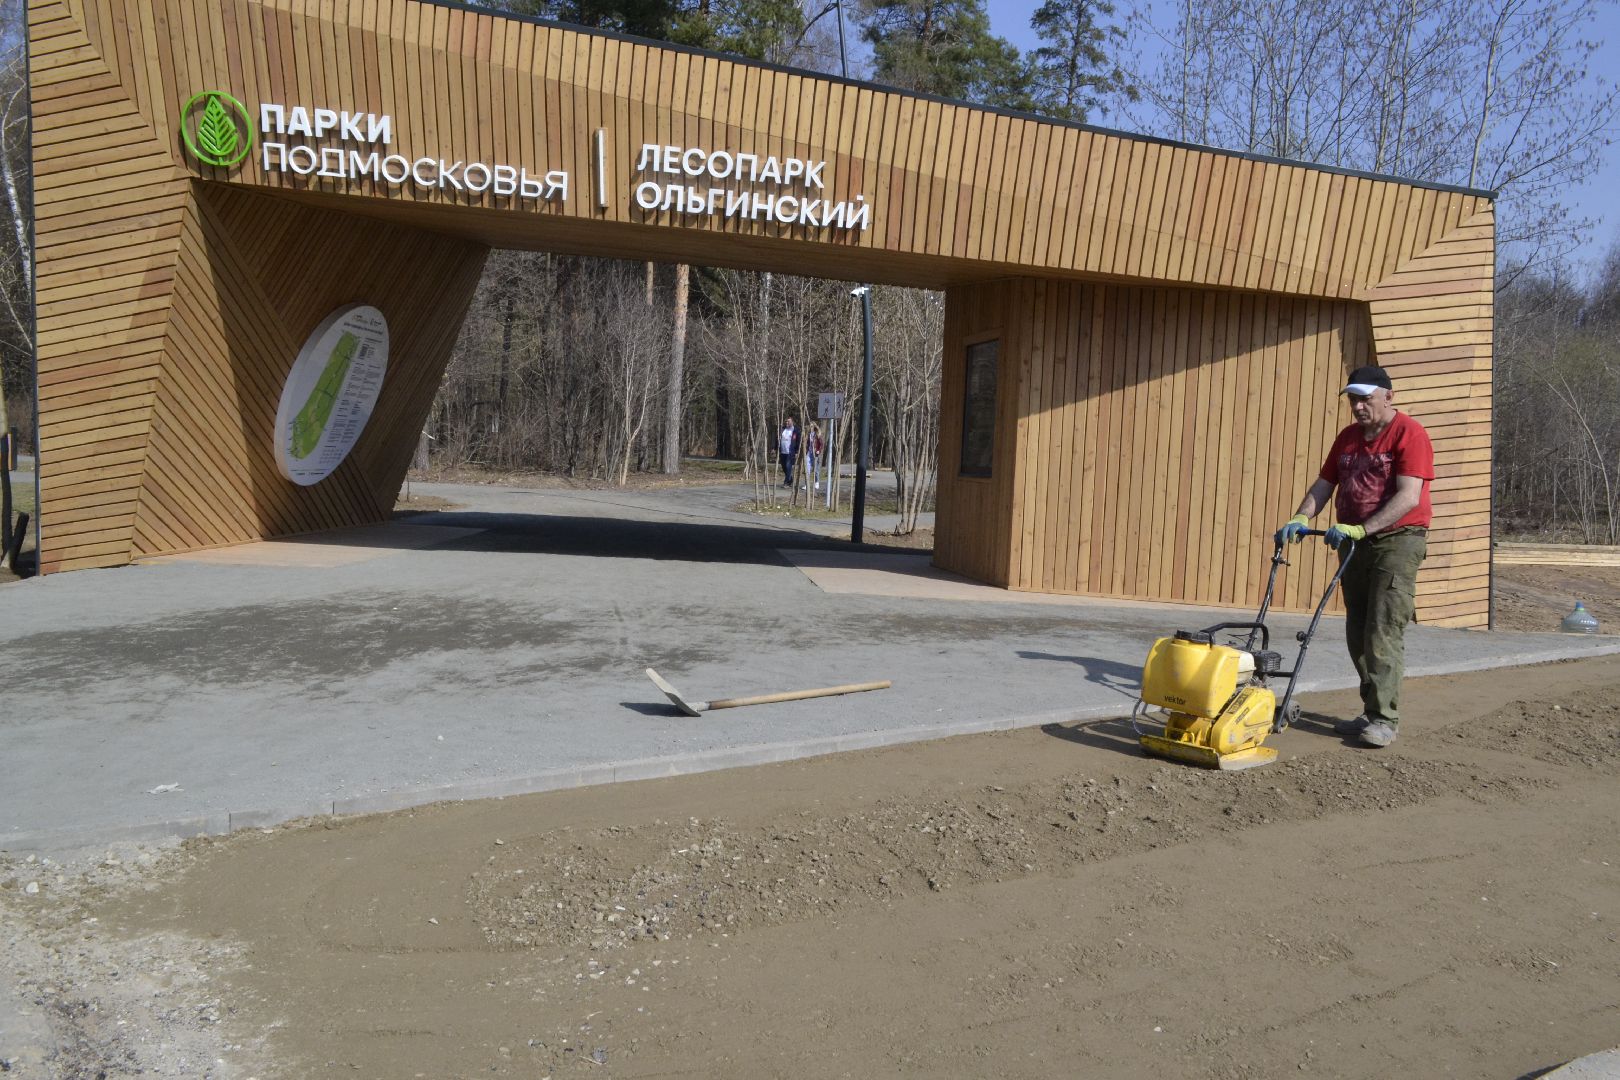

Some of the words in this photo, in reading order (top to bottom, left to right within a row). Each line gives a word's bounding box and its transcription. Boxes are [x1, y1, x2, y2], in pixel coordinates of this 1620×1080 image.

[260, 103, 392, 144] ПАРКИ
[262, 142, 569, 202] ПОДМОСКОВЬЯ
[637, 143, 826, 189] ЛЕСОПАРК
[635, 181, 870, 231] ОЛЬГИНСКИЙ
[1164, 695, 1186, 705] vektor
